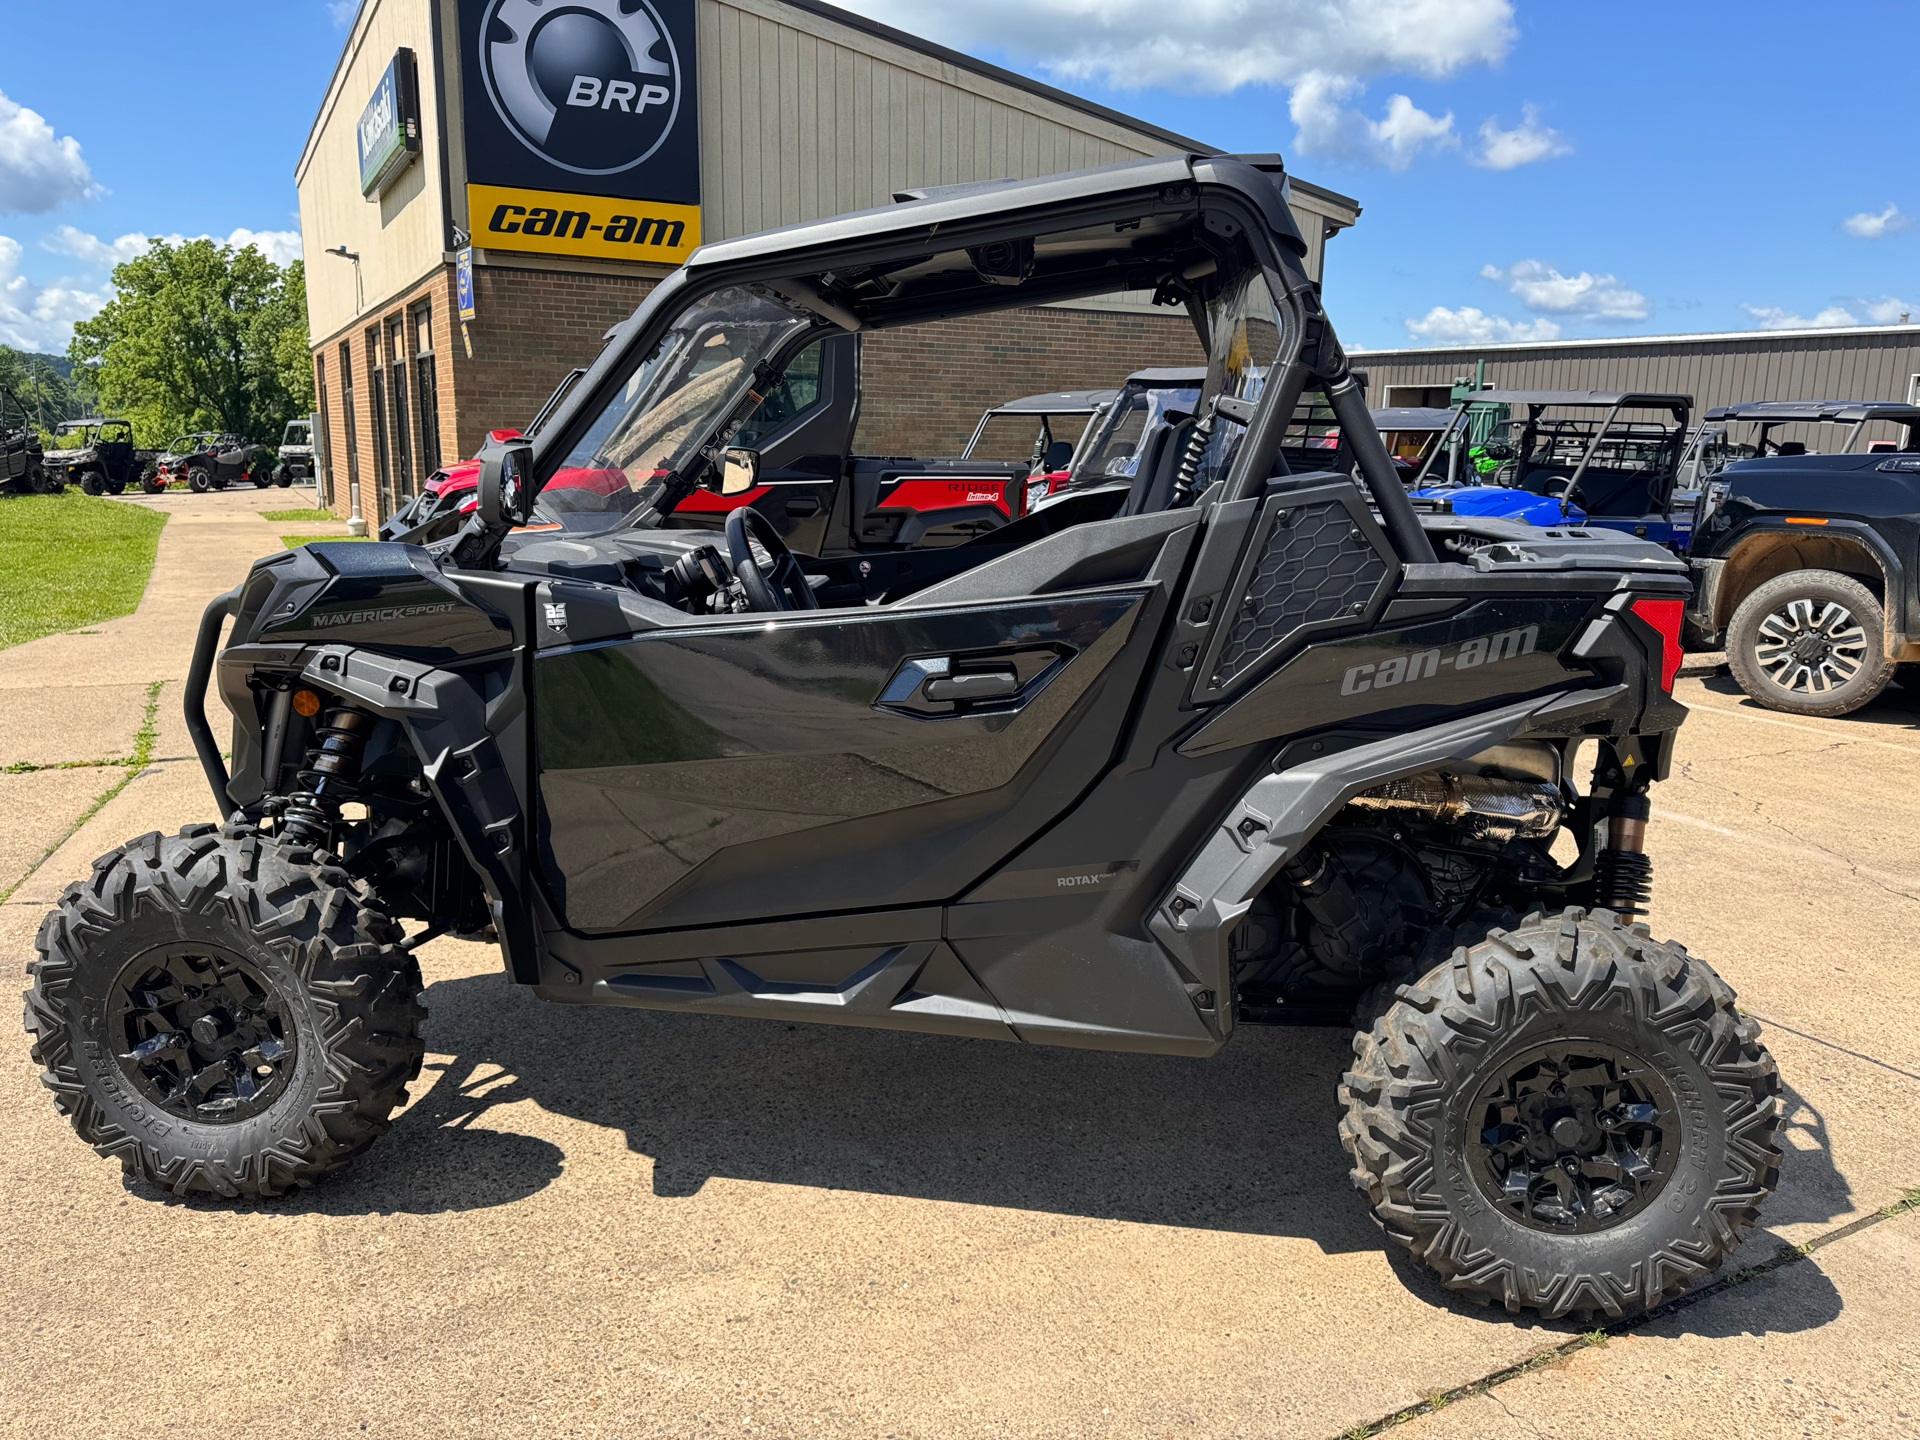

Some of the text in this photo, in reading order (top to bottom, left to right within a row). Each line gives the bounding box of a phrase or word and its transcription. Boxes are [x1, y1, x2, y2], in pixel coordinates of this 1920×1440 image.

[566, 75, 670, 114] BRP
[488, 204, 685, 247] can-am
[948, 483, 1000, 491] RIDGE
[1340, 625, 1539, 696] can-am
[1057, 875, 1100, 887] ROTAX
[246, 944, 317, 1060] MAXXIS
[83, 1041, 172, 1137] BIGHORN
[1652, 1051, 1709, 1170] BIGHORN
